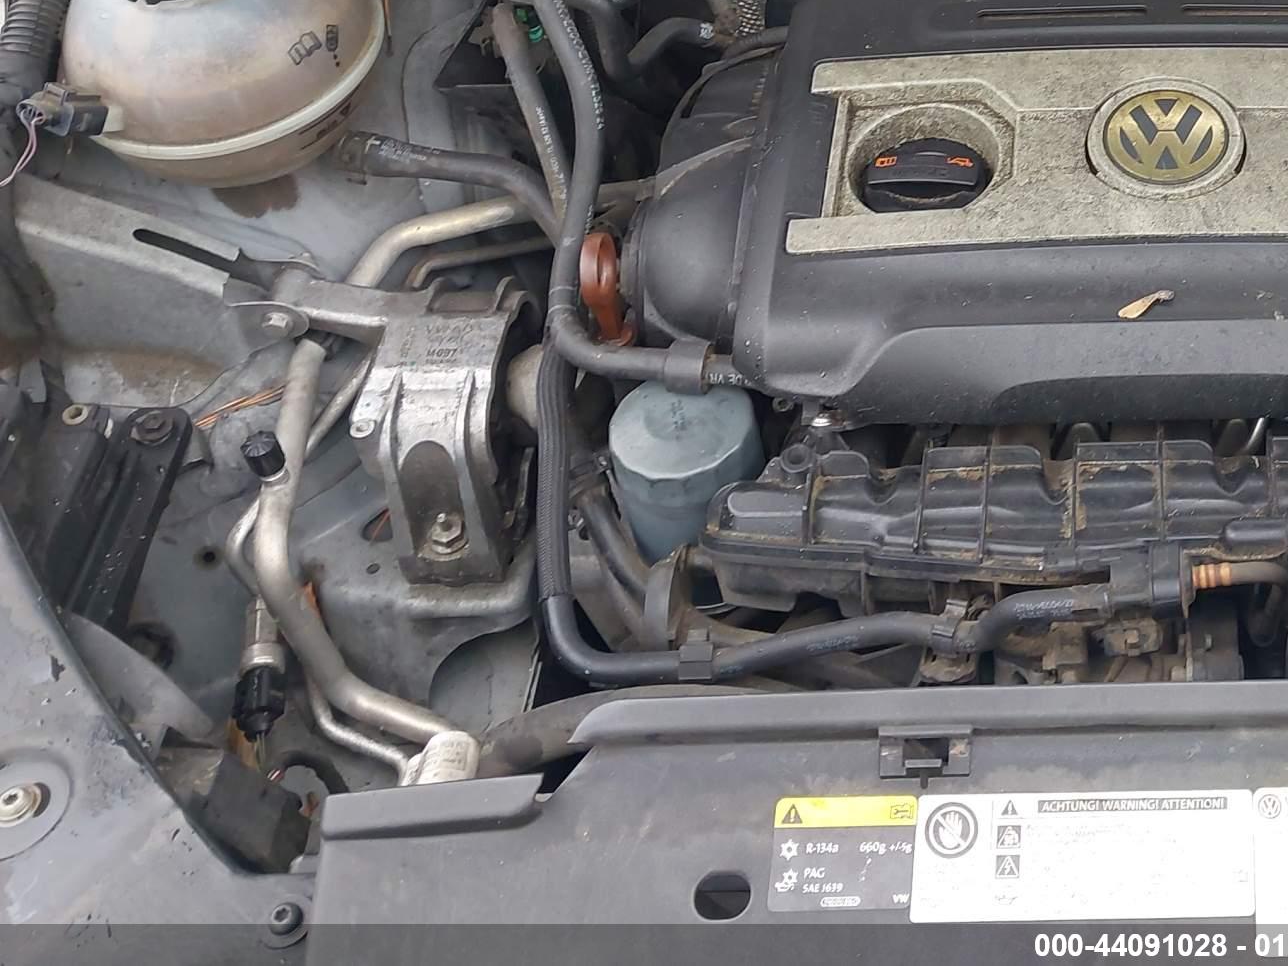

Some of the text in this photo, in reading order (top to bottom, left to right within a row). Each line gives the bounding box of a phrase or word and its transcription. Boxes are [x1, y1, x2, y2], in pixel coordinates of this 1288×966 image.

[1041, 797, 1225, 812] ACHTUNG! WARNING! ATTENTION!
[806, 842, 839, 854] R-134a
[803, 867, 825, 879] PAG
[802, 883, 820, 893] SAE
[892, 893, 910, 904] VW
